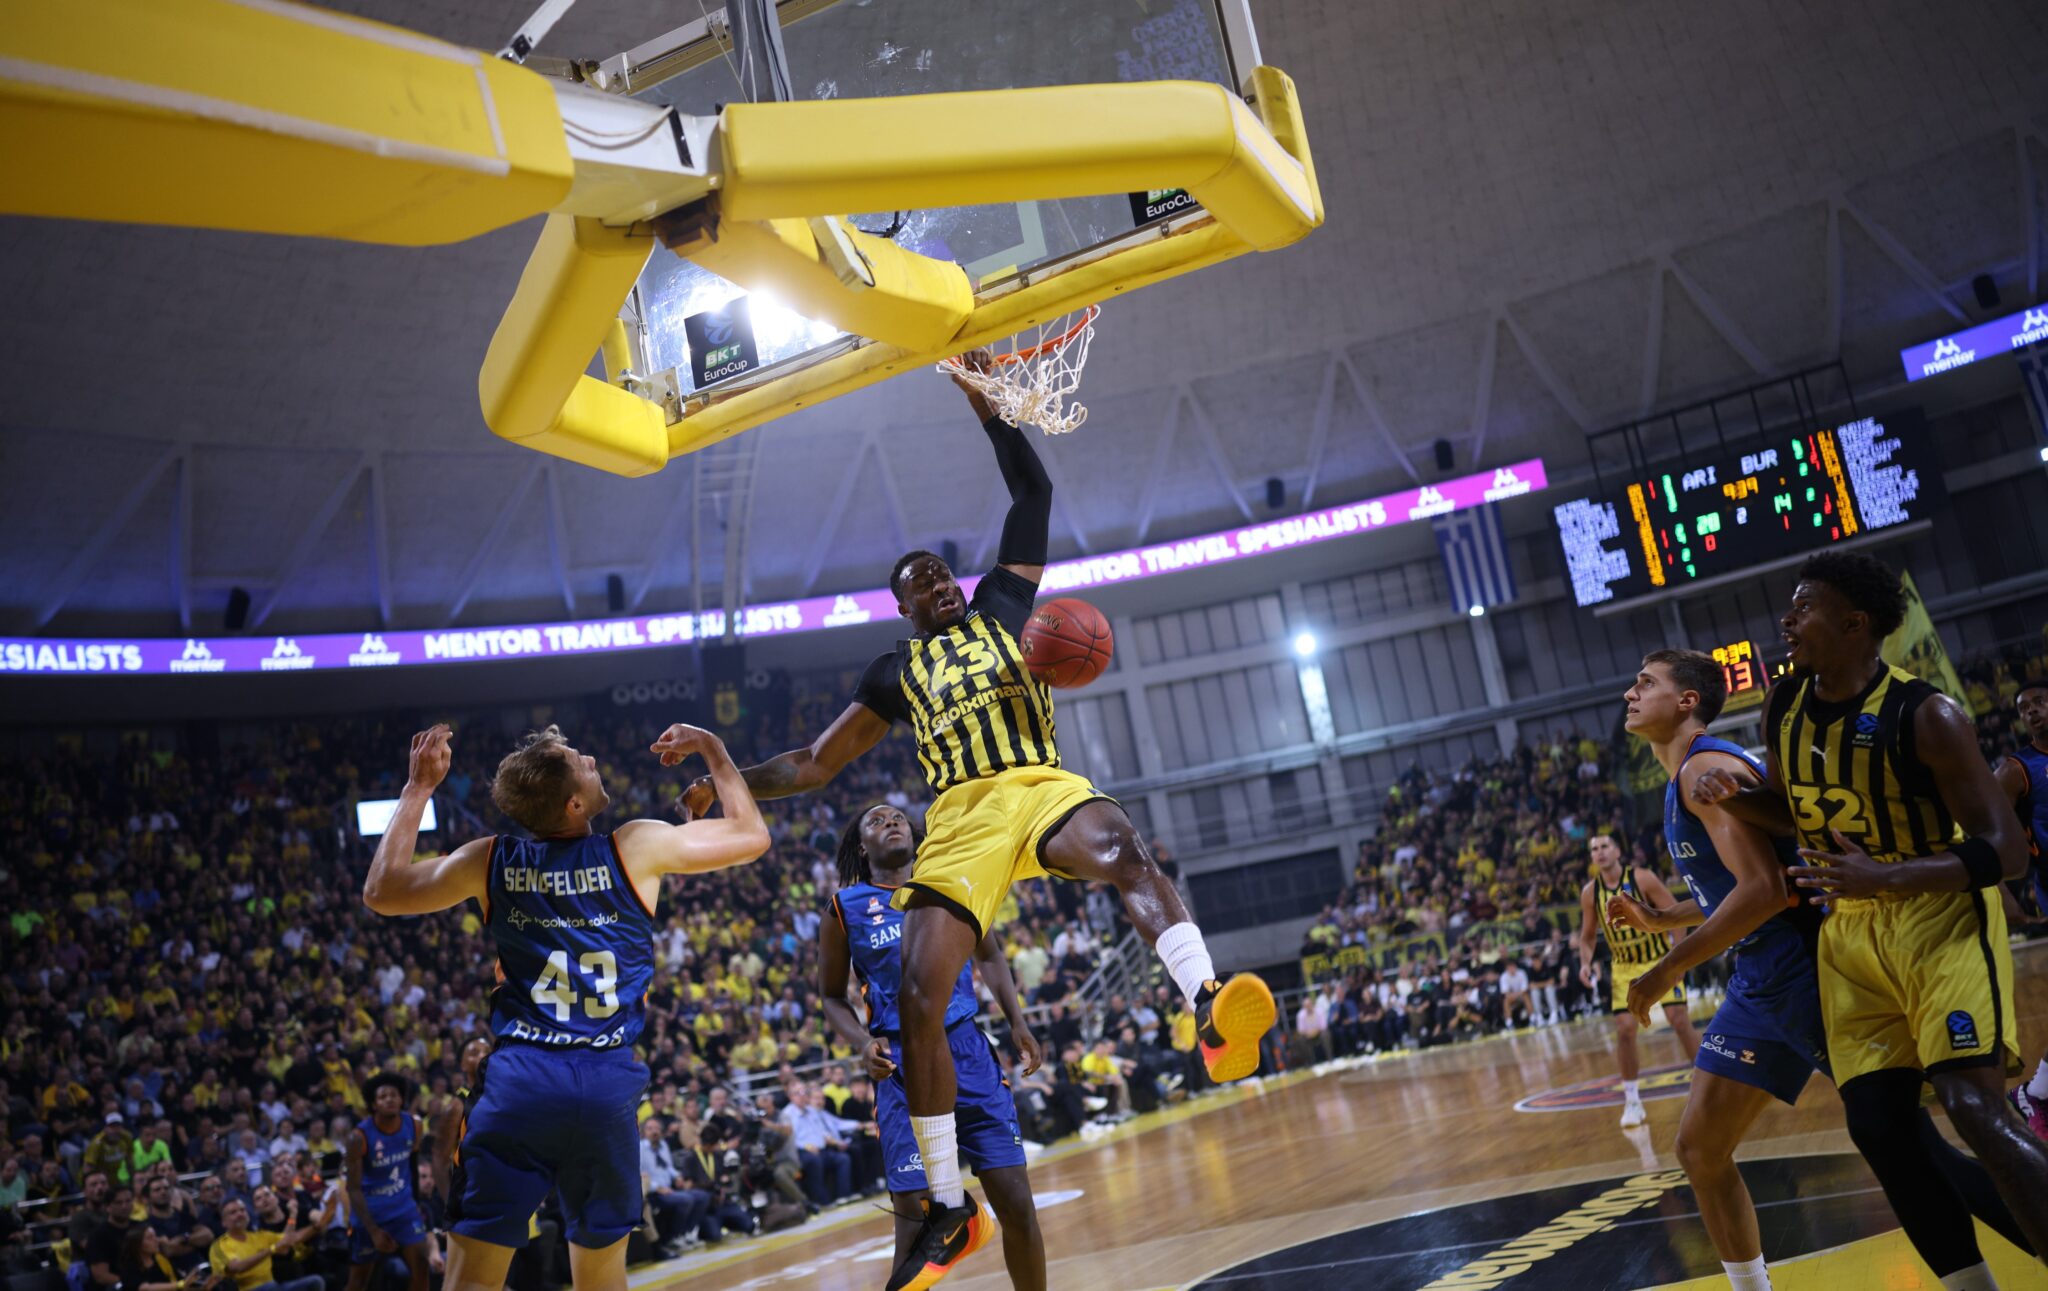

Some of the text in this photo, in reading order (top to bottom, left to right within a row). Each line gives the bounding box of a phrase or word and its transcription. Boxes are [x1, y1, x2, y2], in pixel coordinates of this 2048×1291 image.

[2011, 325, 2048, 348] ment
[704, 360, 748, 382] EuroCup
[706, 344, 741, 369] BKT
[1923, 349, 1976, 376] mentor
[1682, 448, 1779, 492] ARI BUR
[1037, 501, 1387, 592] MENTOR TRAVEL SPESIALISTS
[424, 628, 542, 659] MENTOR
[544, 621, 644, 652] TRAVEL
[1712, 640, 1752, 666] 9:39
[929, 639, 998, 696] 43
[1724, 661, 1753, 693] 13
[931, 683, 1029, 738] Stoiximan
[1791, 784, 1868, 834] 32
[870, 923, 902, 949] SAN
[530, 950, 620, 1022] 43
[1700, 1040, 1737, 1059] LEXUS
